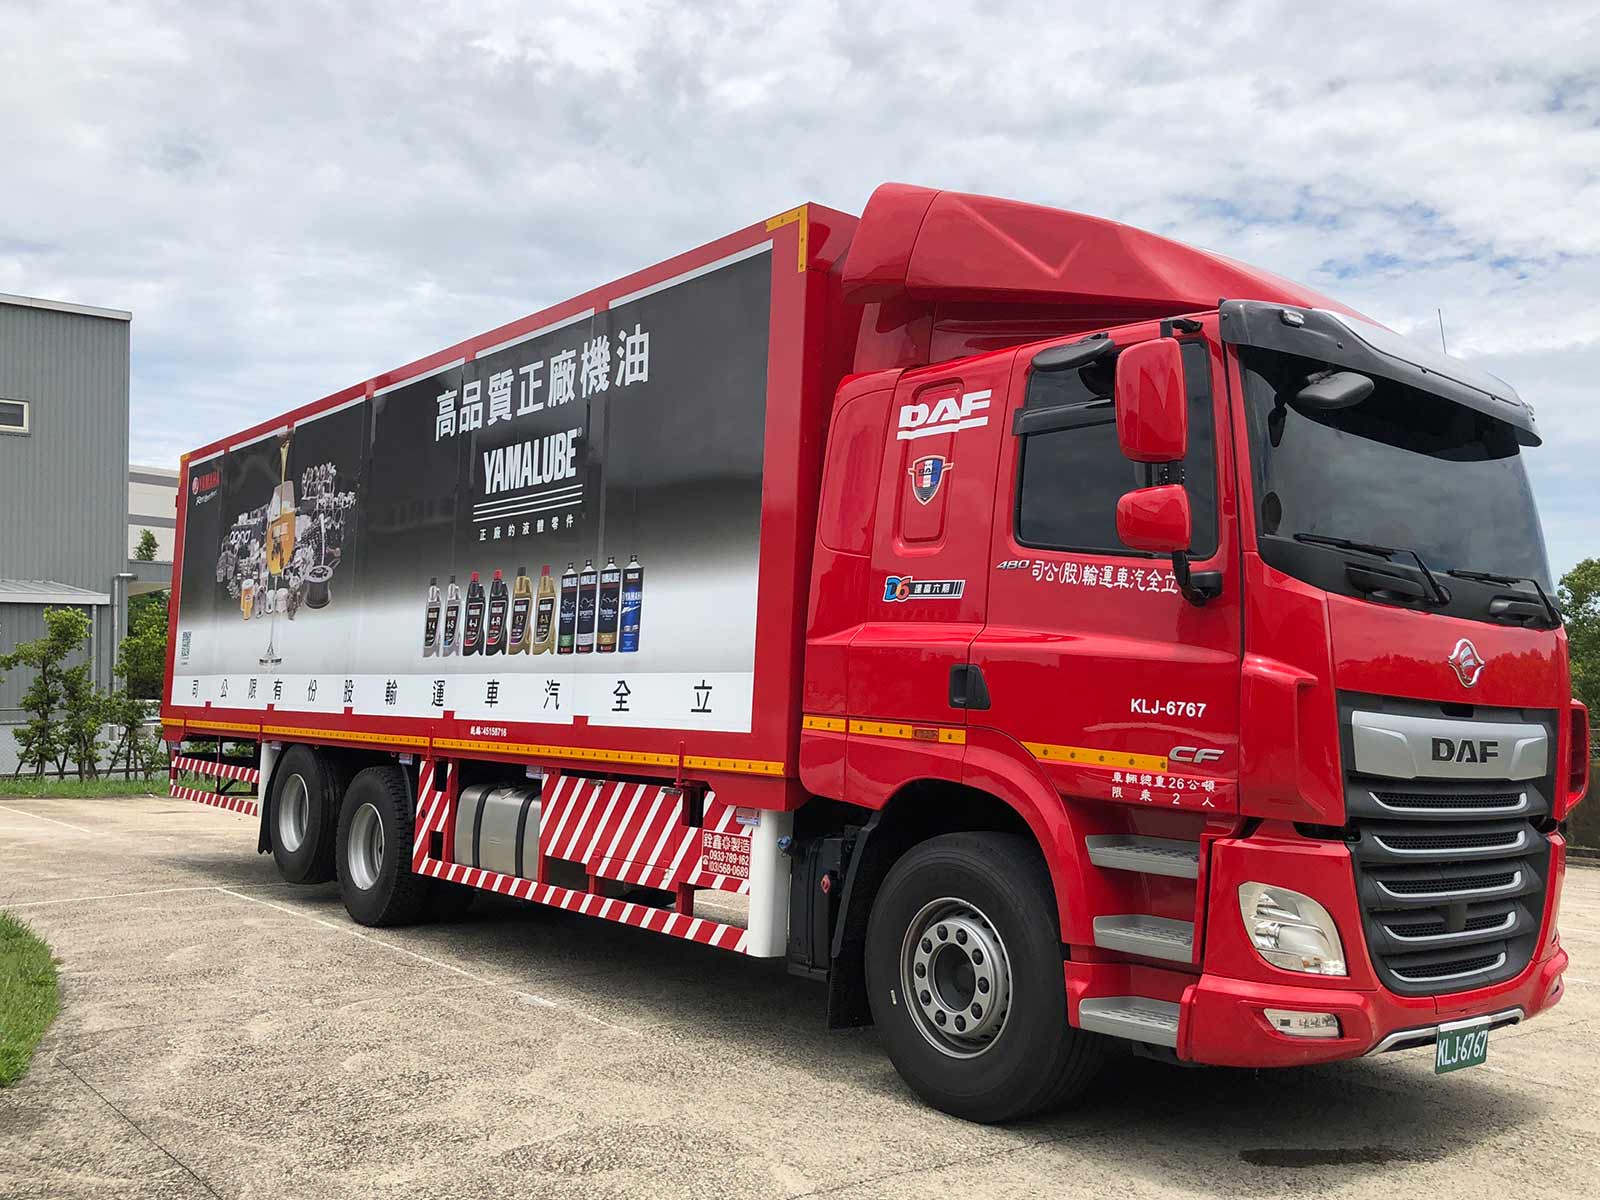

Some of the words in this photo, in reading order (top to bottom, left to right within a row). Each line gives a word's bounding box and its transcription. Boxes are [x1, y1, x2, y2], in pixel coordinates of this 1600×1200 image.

[435, 323, 649, 441] 高品質正廠機油
[898, 389, 992, 428] DAF
[484, 428, 577, 494] YAMALUBE
[996, 559, 1030, 570] 480
[1130, 698, 1207, 718] KLJ-6767
[1168, 745, 1225, 764] CF
[1431, 737, 1499, 763] DAF
